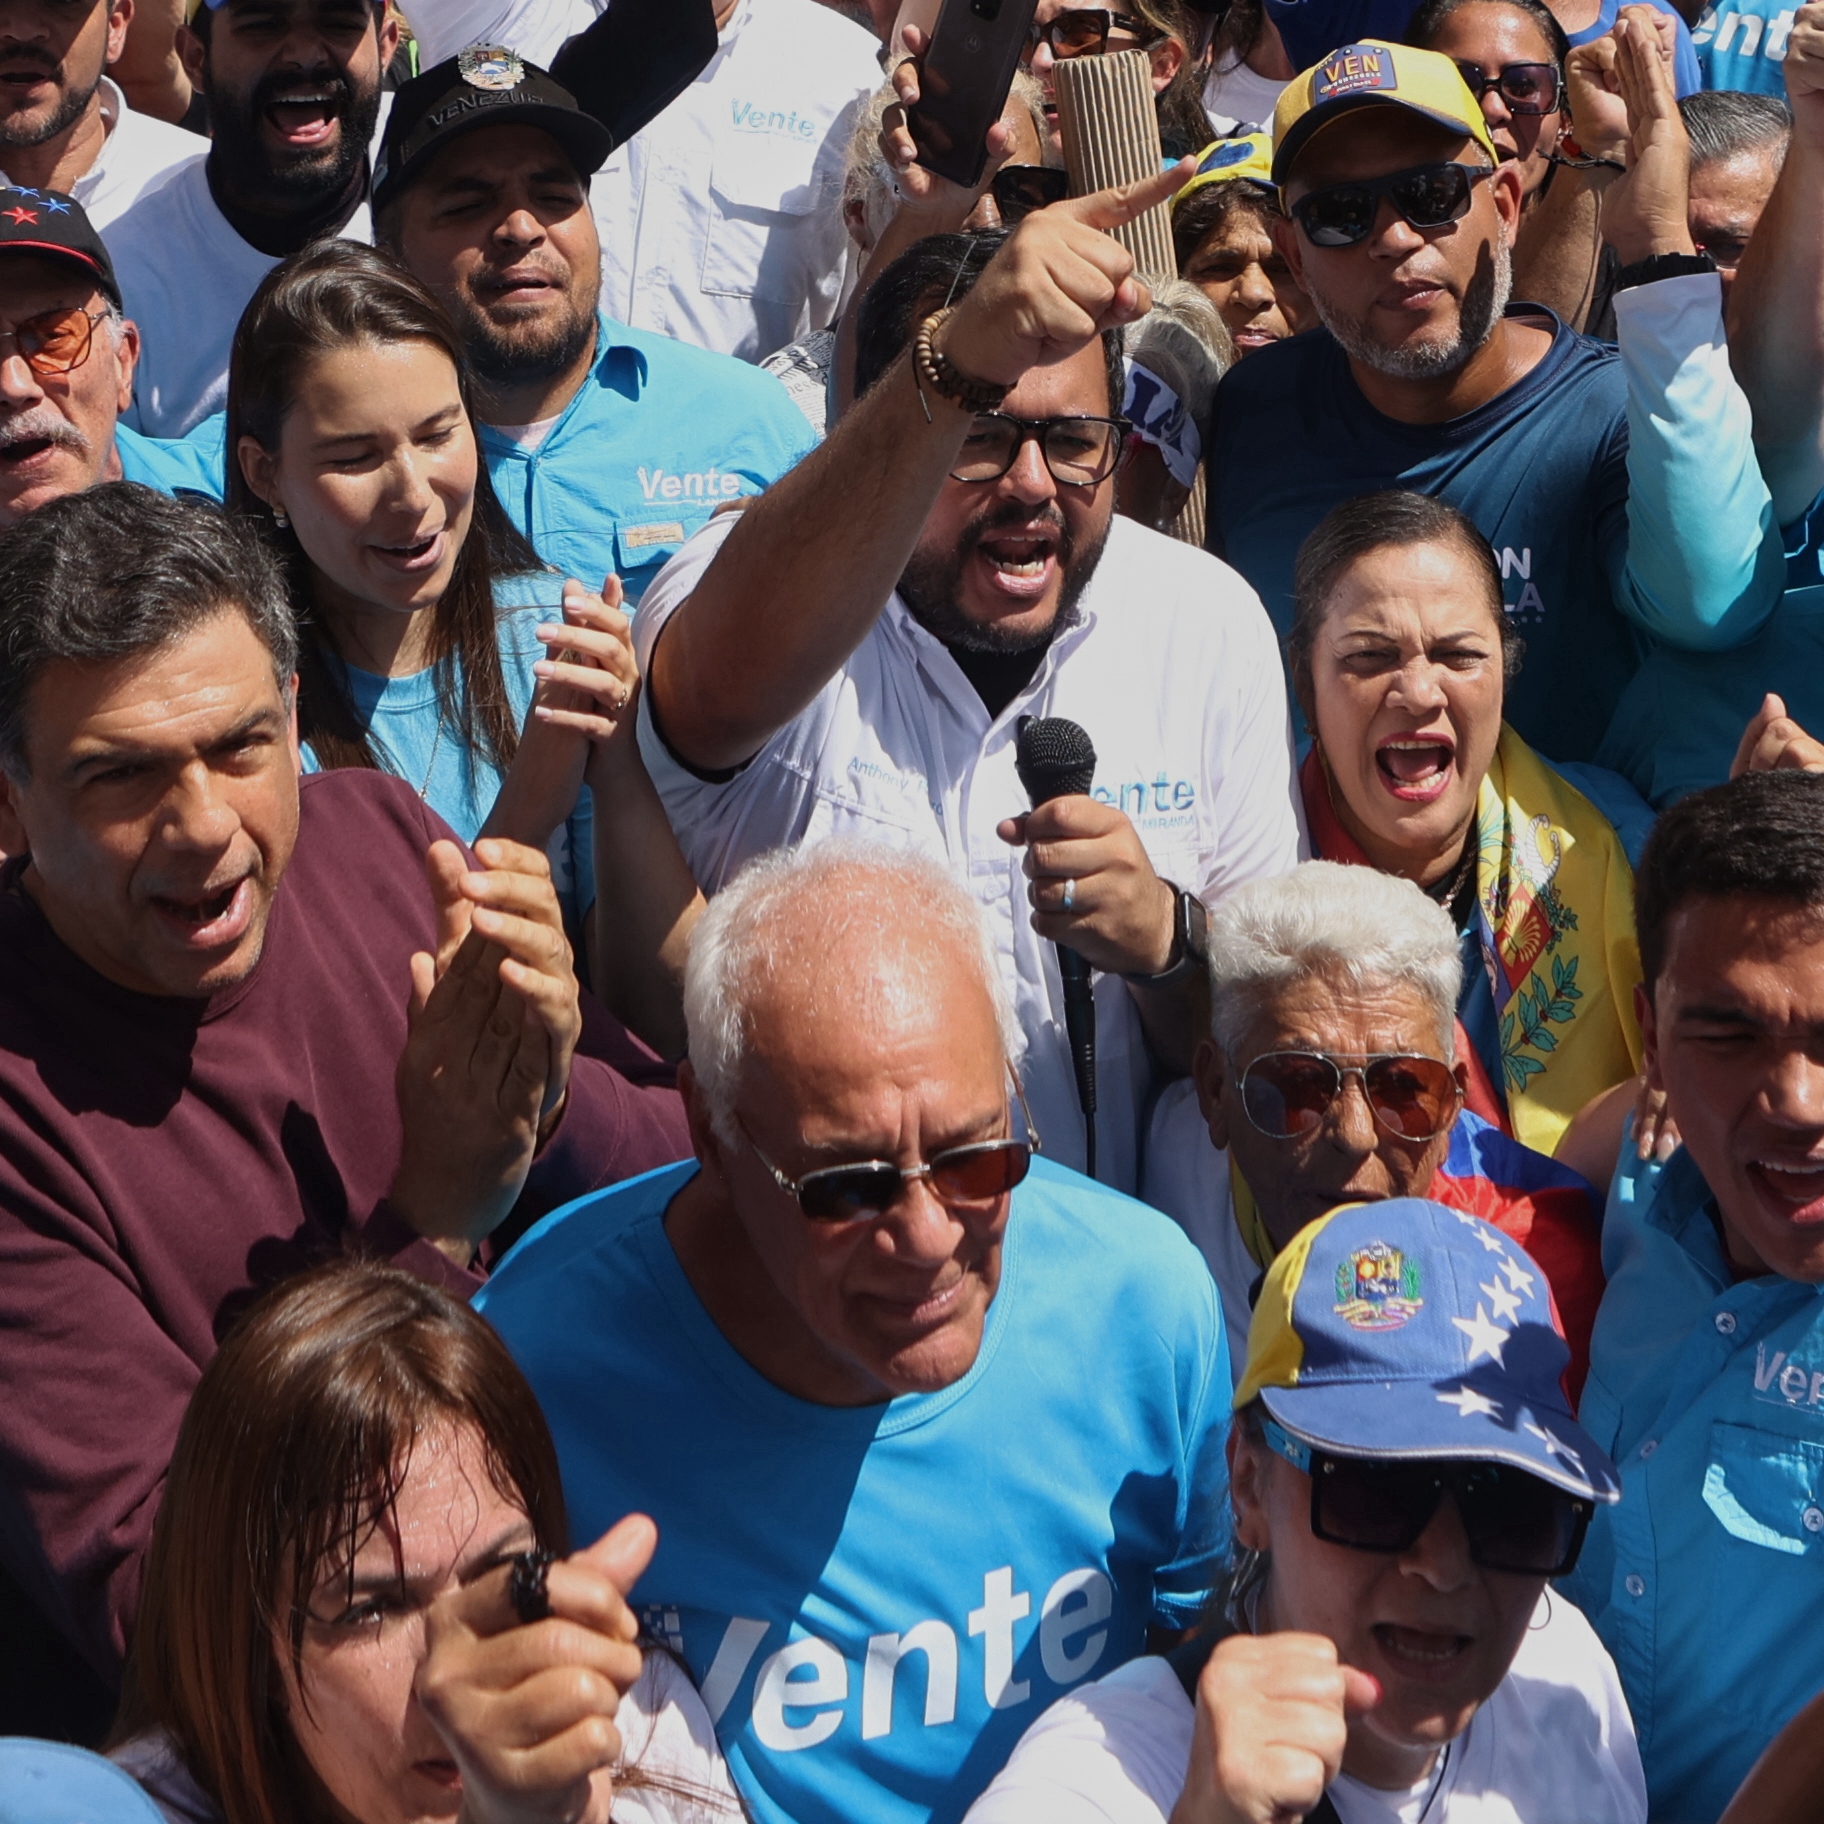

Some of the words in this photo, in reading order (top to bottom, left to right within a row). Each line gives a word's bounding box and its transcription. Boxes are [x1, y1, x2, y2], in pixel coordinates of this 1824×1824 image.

[1691, 10, 1795, 63] ent
[1325, 54, 1380, 83] VEN
[731, 97, 816, 138] Vente
[637, 465, 740, 500] Vente
[847, 755, 909, 794] Anthony
[1091, 770, 1196, 817] ente
[1141, 814, 1196, 832] MIRANDA
[646, 1566, 1114, 1751] Vente
